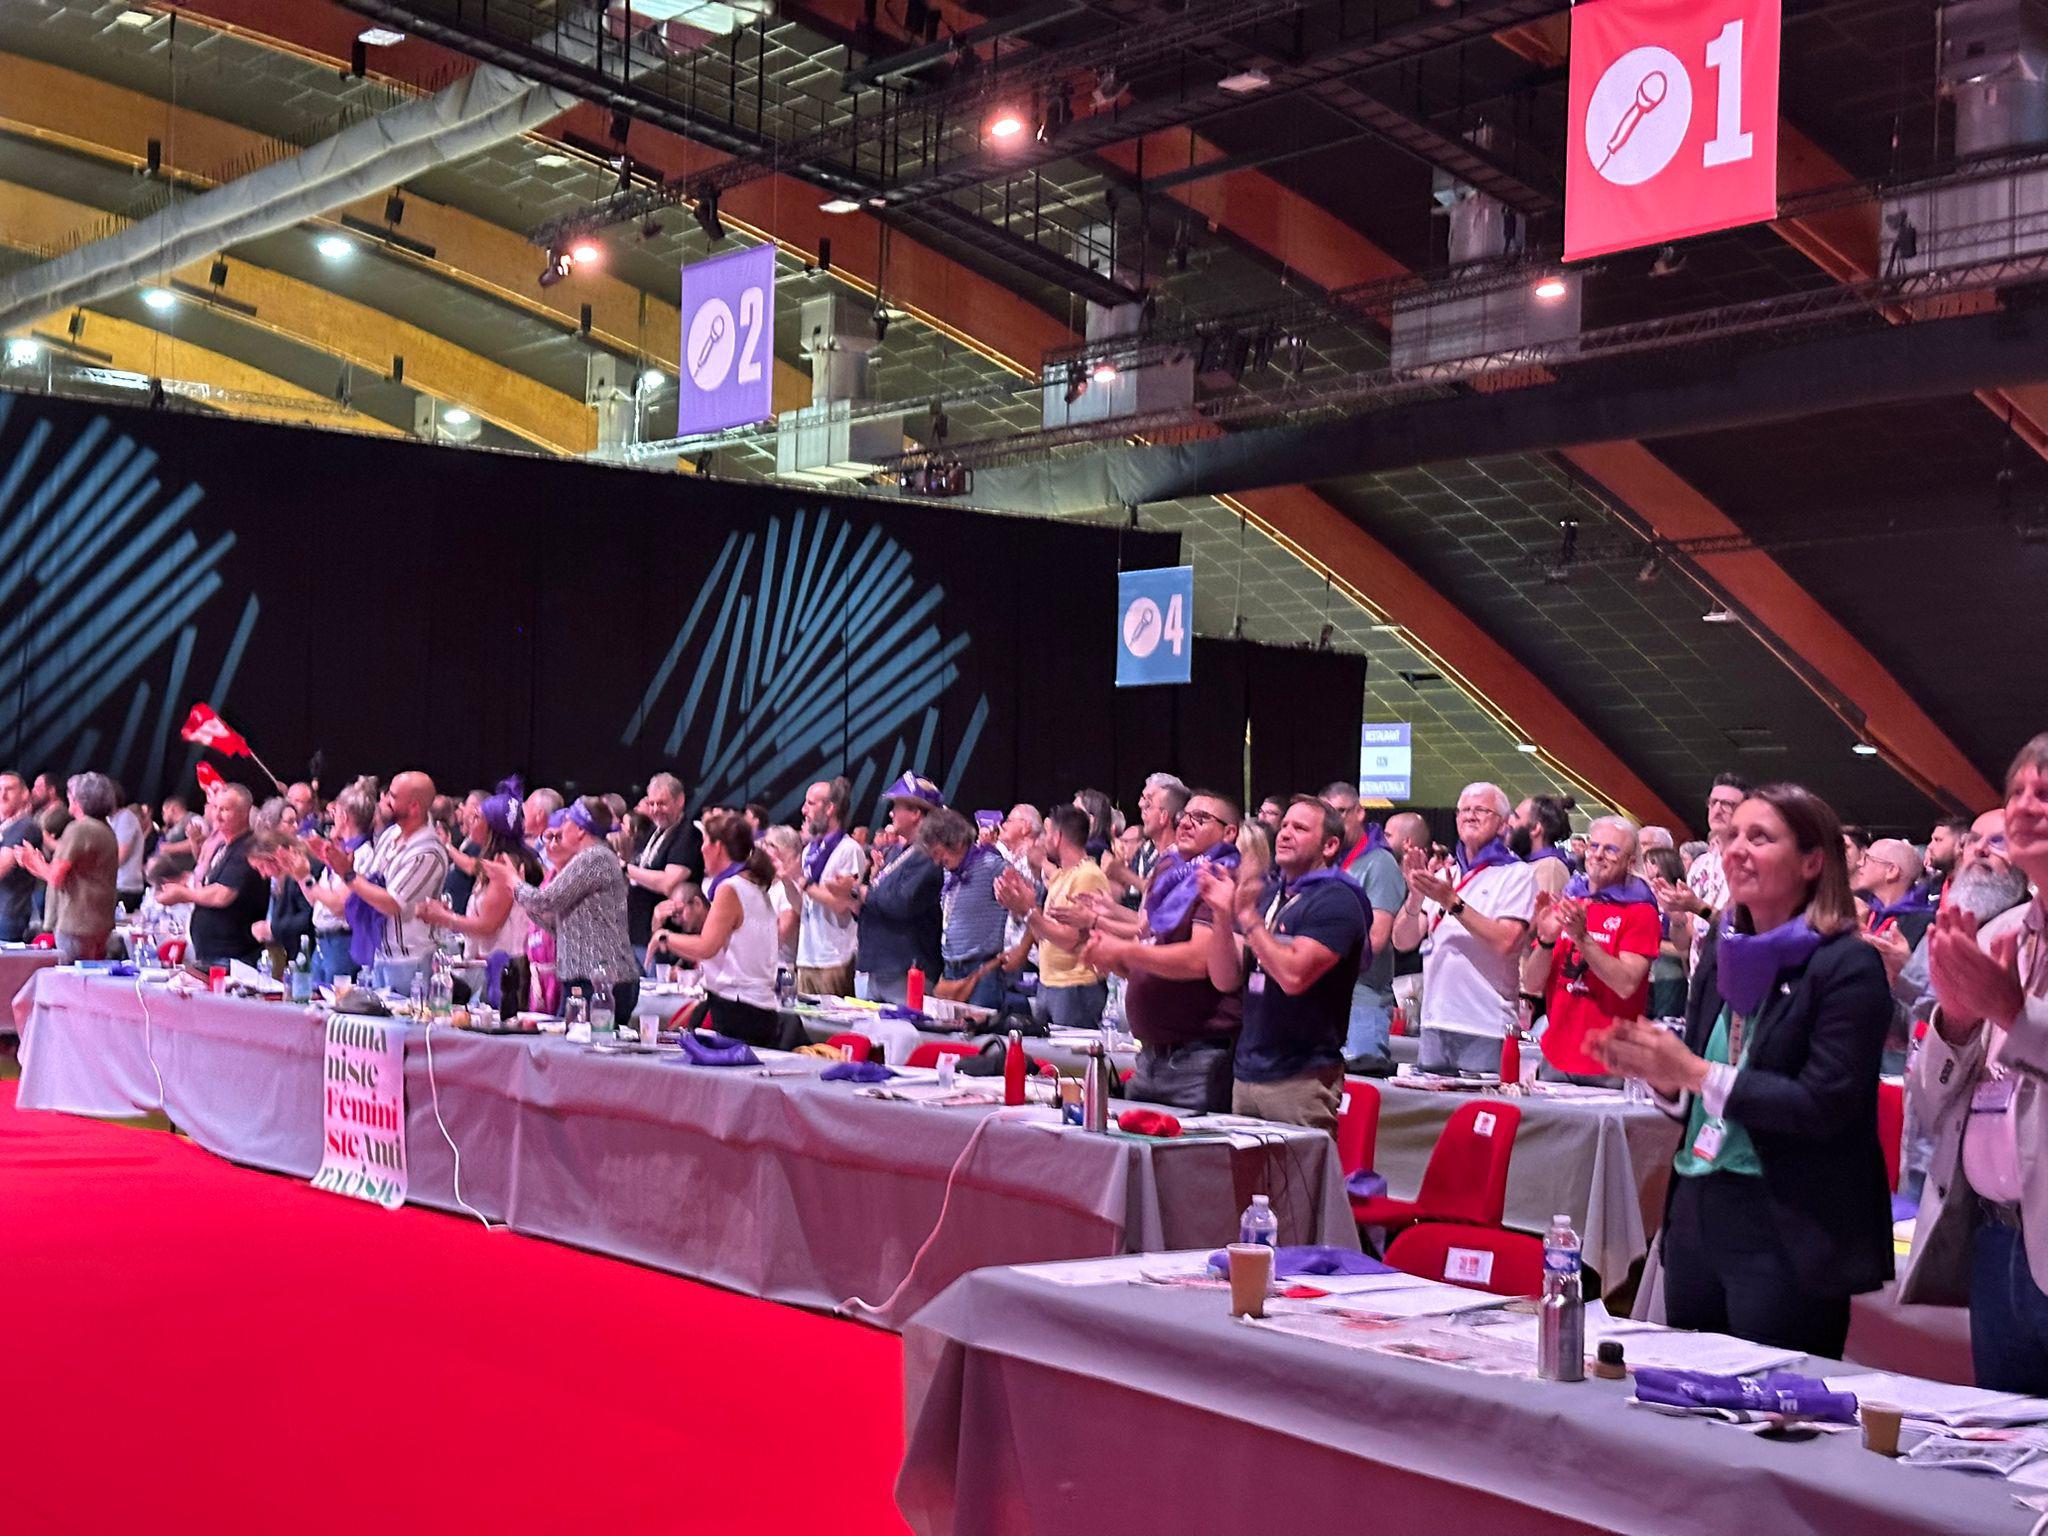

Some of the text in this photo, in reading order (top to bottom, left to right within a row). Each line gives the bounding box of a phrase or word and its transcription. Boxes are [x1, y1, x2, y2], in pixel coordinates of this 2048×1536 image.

[1703, 18, 1753, 169] 1
[738, 286, 764, 385] 2
[1163, 593, 1184, 656] 4
[327, 1049, 379, 1088] niste
[326, 1129, 403, 1171] ste Anti
